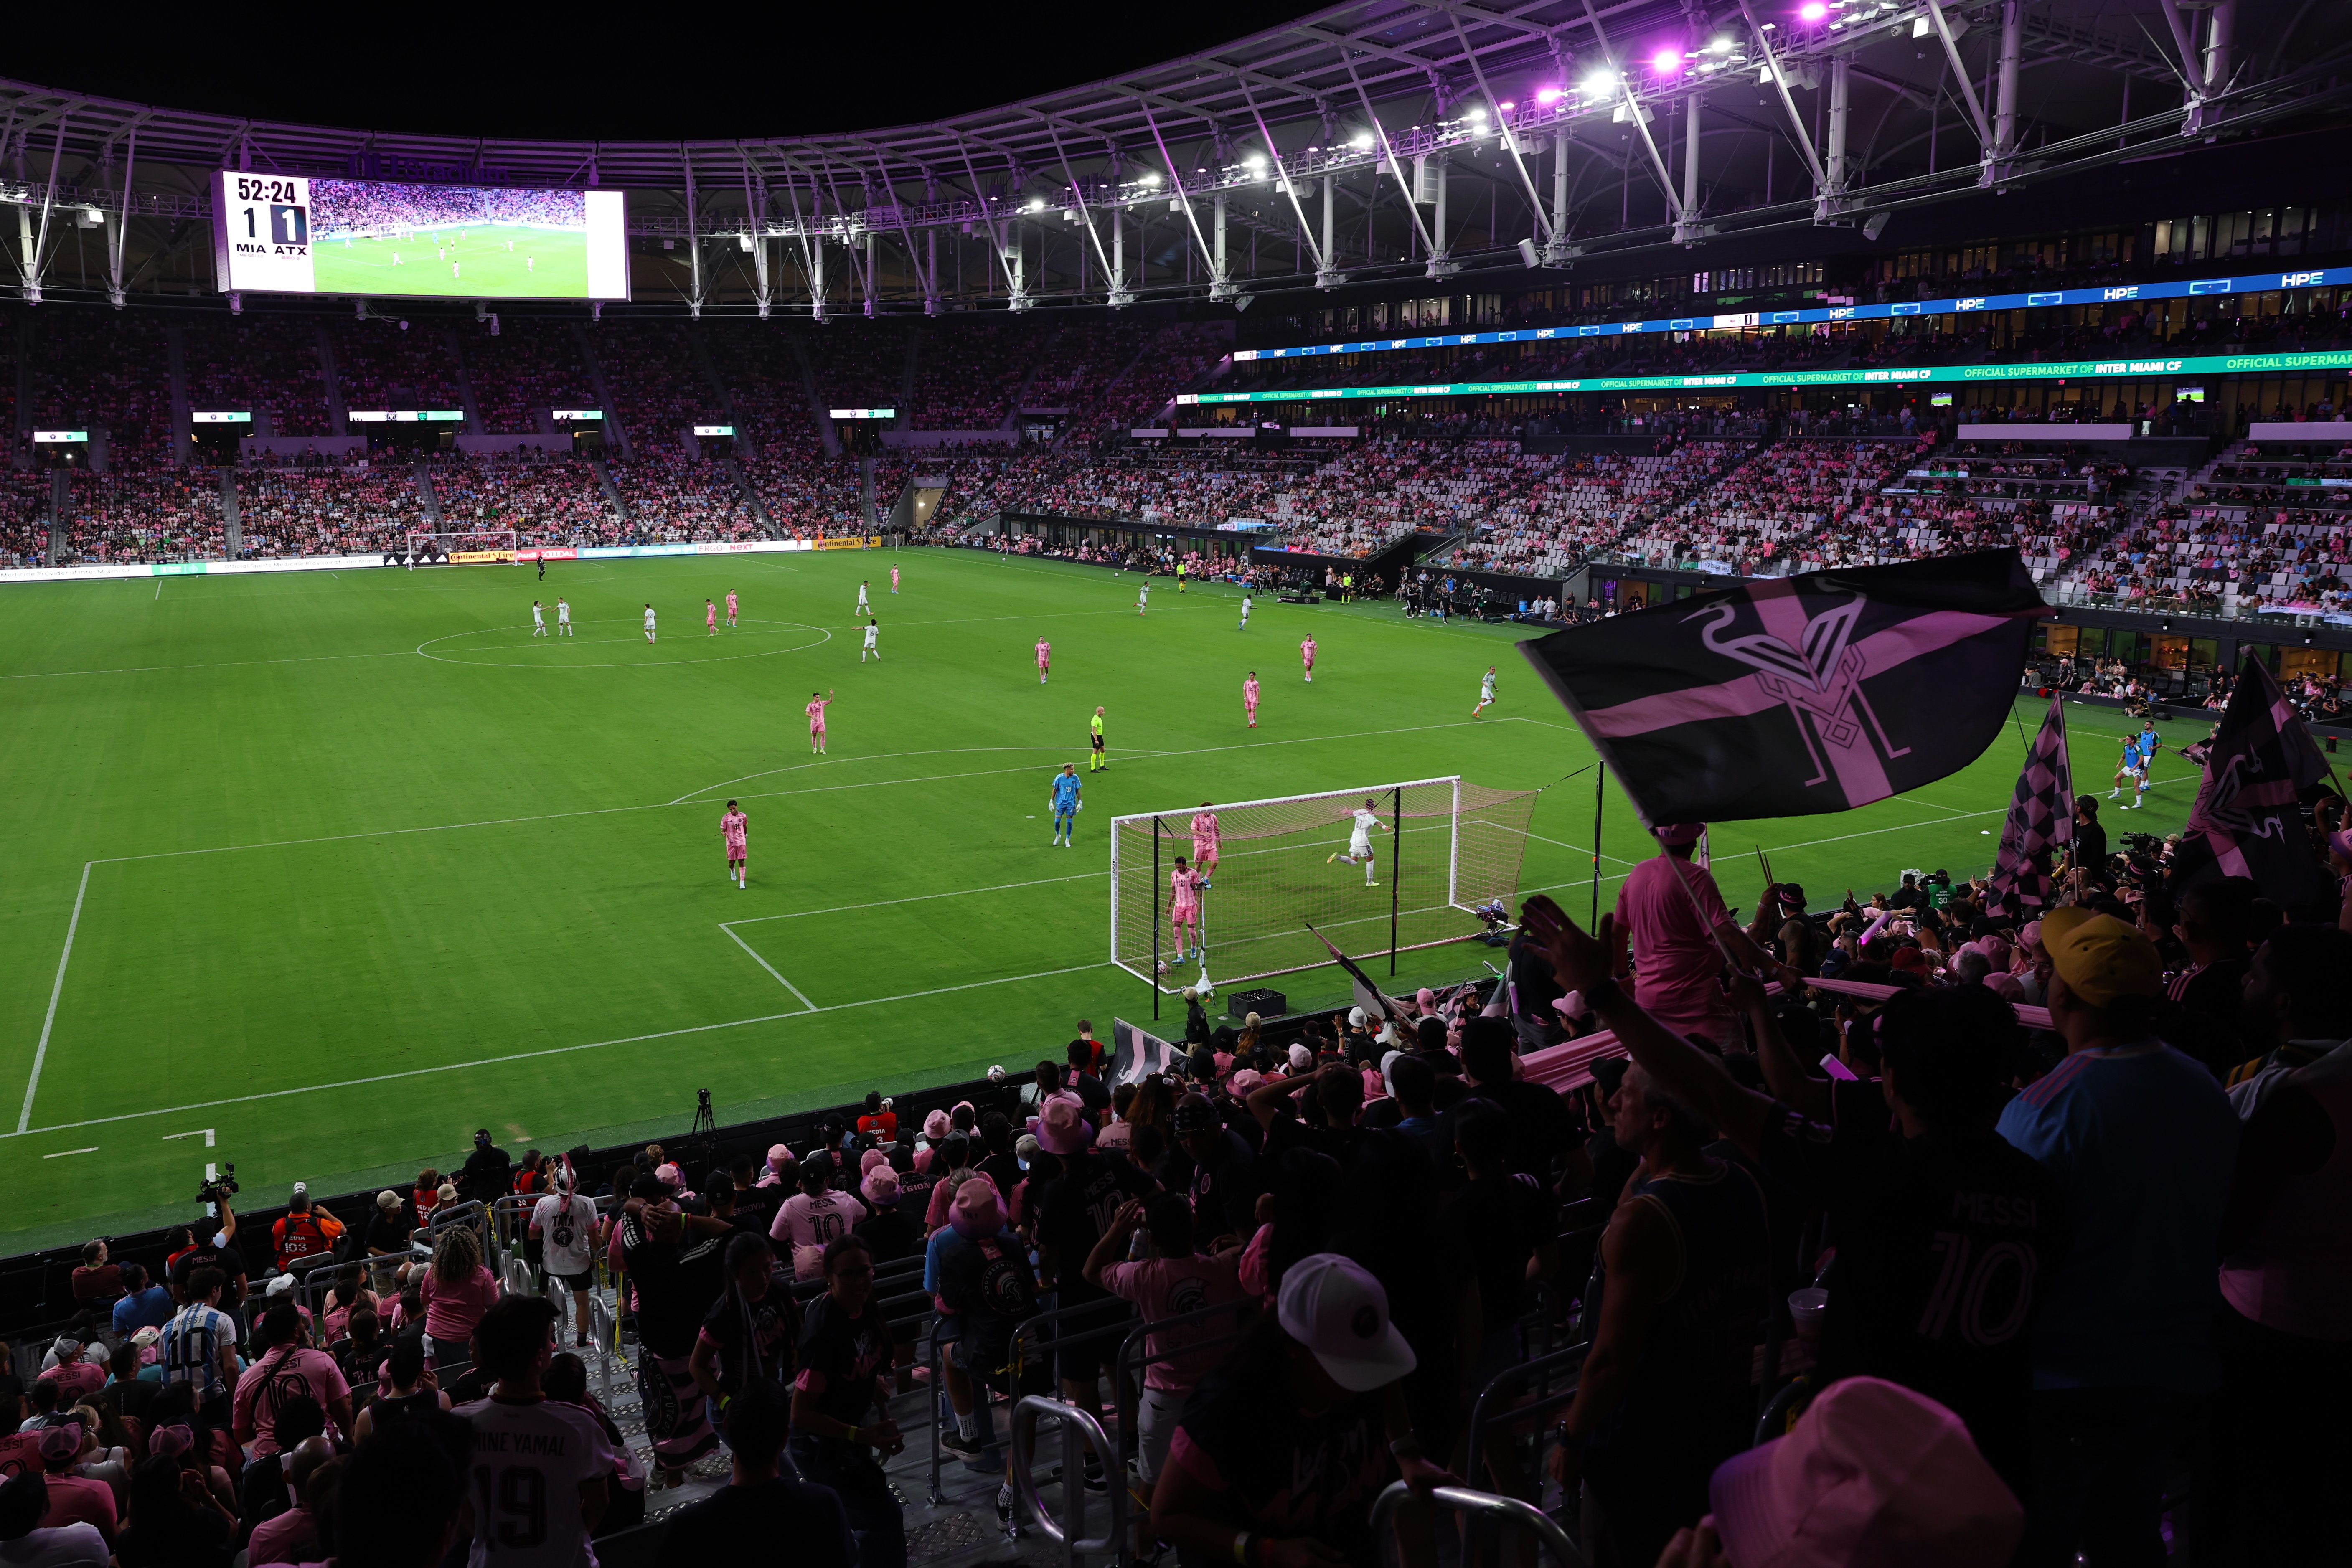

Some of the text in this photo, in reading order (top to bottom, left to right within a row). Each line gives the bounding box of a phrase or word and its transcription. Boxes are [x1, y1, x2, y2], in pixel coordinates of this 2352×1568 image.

[404, 158, 511, 184] Stadium
[238, 178, 296, 203] 52:24
[244, 208, 296, 241] 1 1
[236, 244, 307, 256] MIA ATX
[2281, 272, 2324, 287] HPE
[2104, 287, 2139, 300] HPE
[1956, 298, 1985, 311] HPE
[1747, 315, 1750, 324] 1
[1829, 308, 1855, 319] HPE
[1537, 329, 1555, 338] HPE
[1623, 323, 1642, 332] HPE
[1392, 340, 1406, 348] HPE
[1460, 335, 1476, 343] HPE
[1964, 361, 2182, 377] OFFICIAL SUPERMARKET OF INTER MIAMI CF
[2226, 358, 2282, 369] OFFICIAL
[1763, 370, 1931, 383] OFFICIAL SUPERMARKET OF INTER MIAMI CF
[450, 551, 514, 561] Continental Tire
[902, 1182, 931, 1194] EGION
[1084, 1170, 1116, 1198] MESSI
[733, 1201, 766, 1216] SEGOVIA
[810, 1198, 837, 1210] MESSI
[1953, 1190, 2039, 1229] MESSI
[552, 1215, 574, 1227] TATA
[808, 1212, 845, 1245] 10
[285, 1242, 307, 1253] 103
[192, 1254, 216, 1264] MESSI
[1916, 1231, 2039, 1348] 10
[167, 1327, 208, 1372] 10
[355, 1353, 375, 1365] MES
[264, 1358, 300, 1375] MSSI
[53, 1370, 81, 1382] MESSI
[473, 1431, 565, 1457] MINE YAMAL
[474, 1464, 547, 1552] 19
